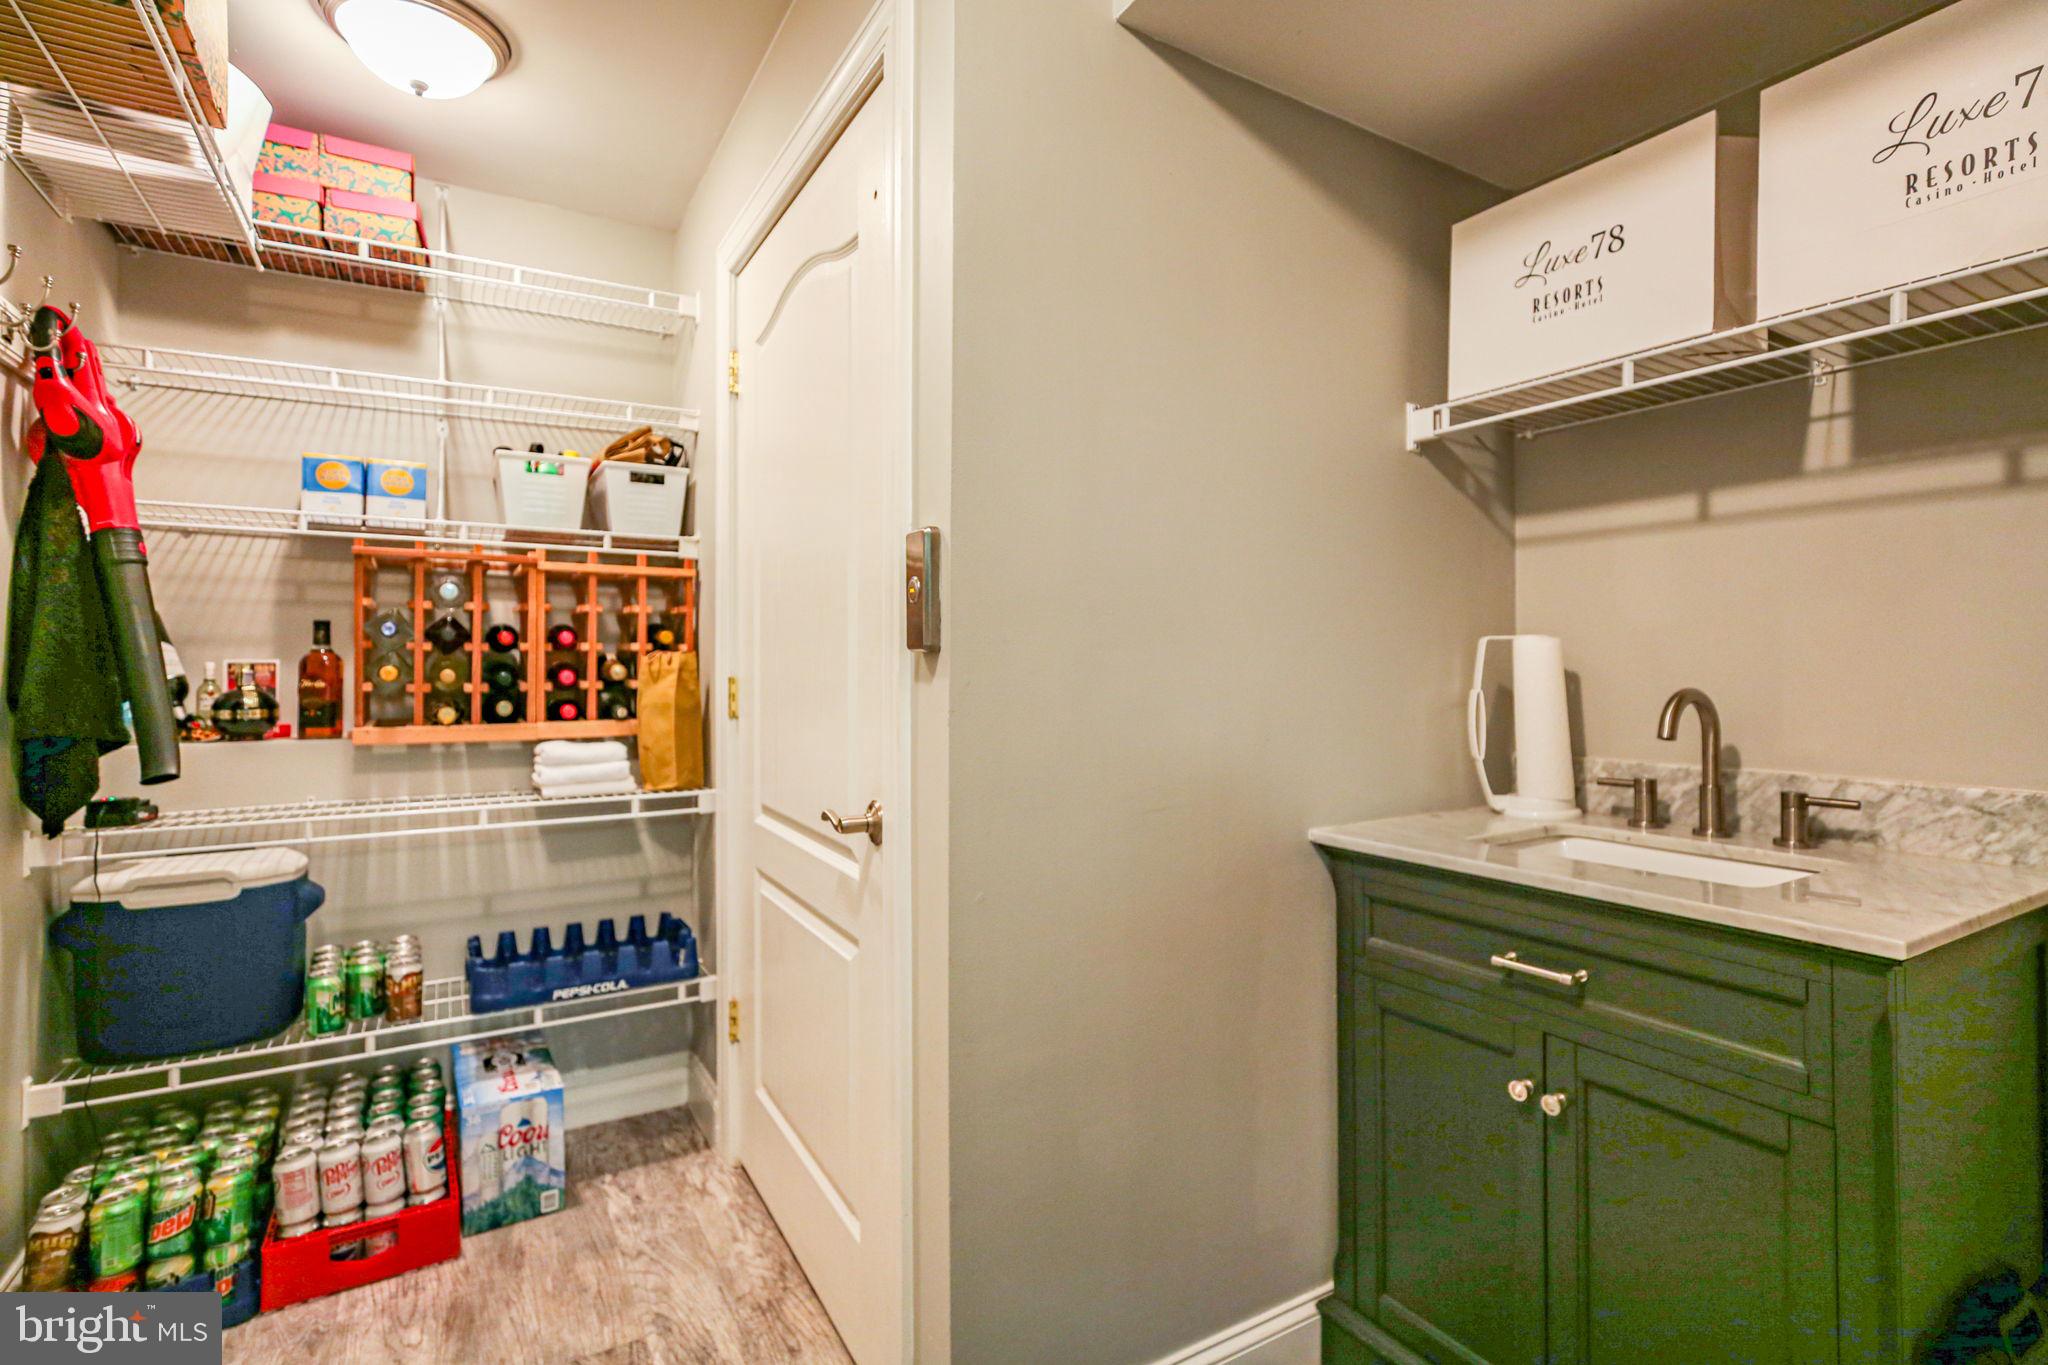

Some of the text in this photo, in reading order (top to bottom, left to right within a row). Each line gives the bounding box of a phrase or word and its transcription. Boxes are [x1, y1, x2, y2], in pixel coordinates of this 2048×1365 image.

[1905, 131, 2039, 196] RESORTS
[1905, 156, 2037, 208] Casino Hotel
[1533, 275, 1604, 314] RESORTS
